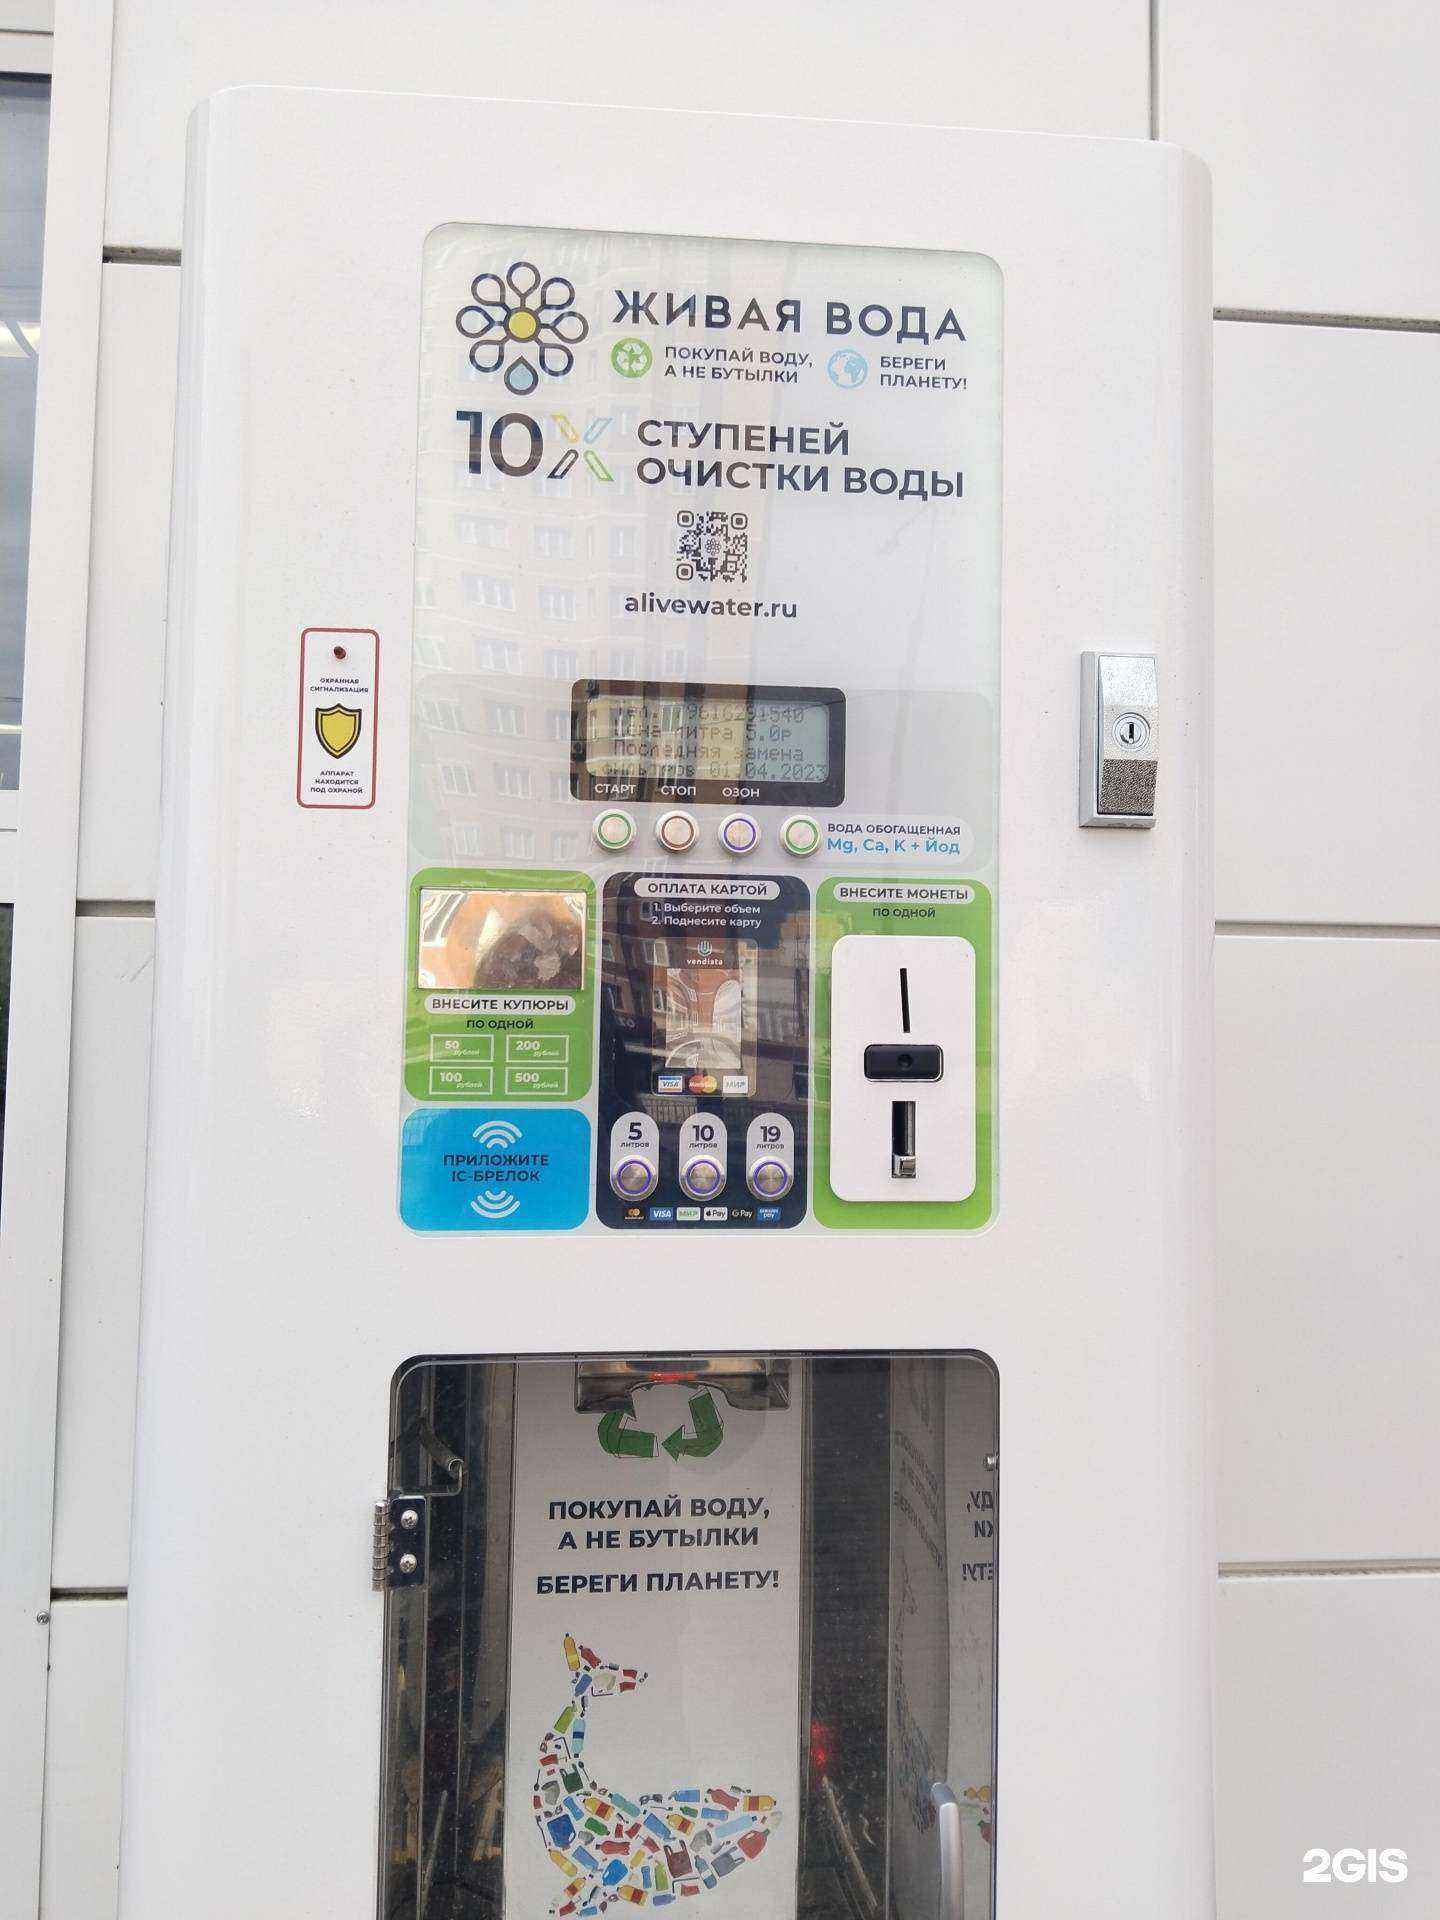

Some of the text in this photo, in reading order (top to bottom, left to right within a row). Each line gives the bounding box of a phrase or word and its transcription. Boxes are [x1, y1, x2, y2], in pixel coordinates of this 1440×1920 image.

[612, 289, 967, 344] ЖИВАЯ ВОДА
[665, 345, 813, 368] ПОКУПАЙ ВОДУ,
[880, 355, 946, 372] БЕРЕГИ
[664, 365, 798, 384] А НЕ БУТЫЛКИ
[880, 374, 968, 391] ПЛАНЕТУ!
[637, 419, 849, 456] СТУПЕНЕЙ
[637, 457, 963, 500] ОЧИСТКИ ВОДЫ
[624, 592, 798, 619] alivewater.ru
[310, 686, 369, 694] СИГНАЛИЗАЦИЯ
[328, 786, 363, 794] ОХРАНОЙ
[595, 783, 636, 795] СТАРТ
[660, 785, 697, 796] СТОП
[722, 787, 760, 798] ОЗОН
[827, 823, 961, 837] ВОДА ОБОГАЩЕННАЯ
[827, 838, 858, 855] Mg,
[863, 838, 889, 853] Ca,
[925, 836, 961, 856] Йод
[647, 882, 768, 896] ОПЛАТА КАРТОЙ
[840, 886, 969, 901] ВНЕСИТЕ МОНЕТЫ
[653, 903, 761, 915] 1. Выберите объем
[873, 907, 936, 920] ПО ОДНОЙ
[652, 916, 762, 929] 2. Поднесите карту
[432, 998, 569, 1011] ВНЕСИТЕ КУПЮРЫ
[466, 1018, 534, 1030] ПО ОДНОЙ
[444, 1040, 460, 1050] 50
[515, 1040, 540, 1051] 200
[440, 1072, 463, 1083] 100
[515, 1072, 540, 1083] 500
[628, 1122, 642, 1141] 5
[692, 1124, 715, 1142] 10
[760, 1125, 781, 1142] 19
[620, 1141, 650, 1149] литров
[688, 1142, 718, 1150] литров
[755, 1142, 785, 1150] литров
[443, 1153, 550, 1167] ПРИЛОЖИТЕ
[653, 1209, 672, 1218] VISA
[549, 1494, 770, 1520] ПОКУПАЙ ВОДУ,
[557, 1527, 759, 1550] А НЕ БУТЫЛКИ
[536, 1569, 780, 1594] БЕРЕГИ ПЛАНЕТУ!
